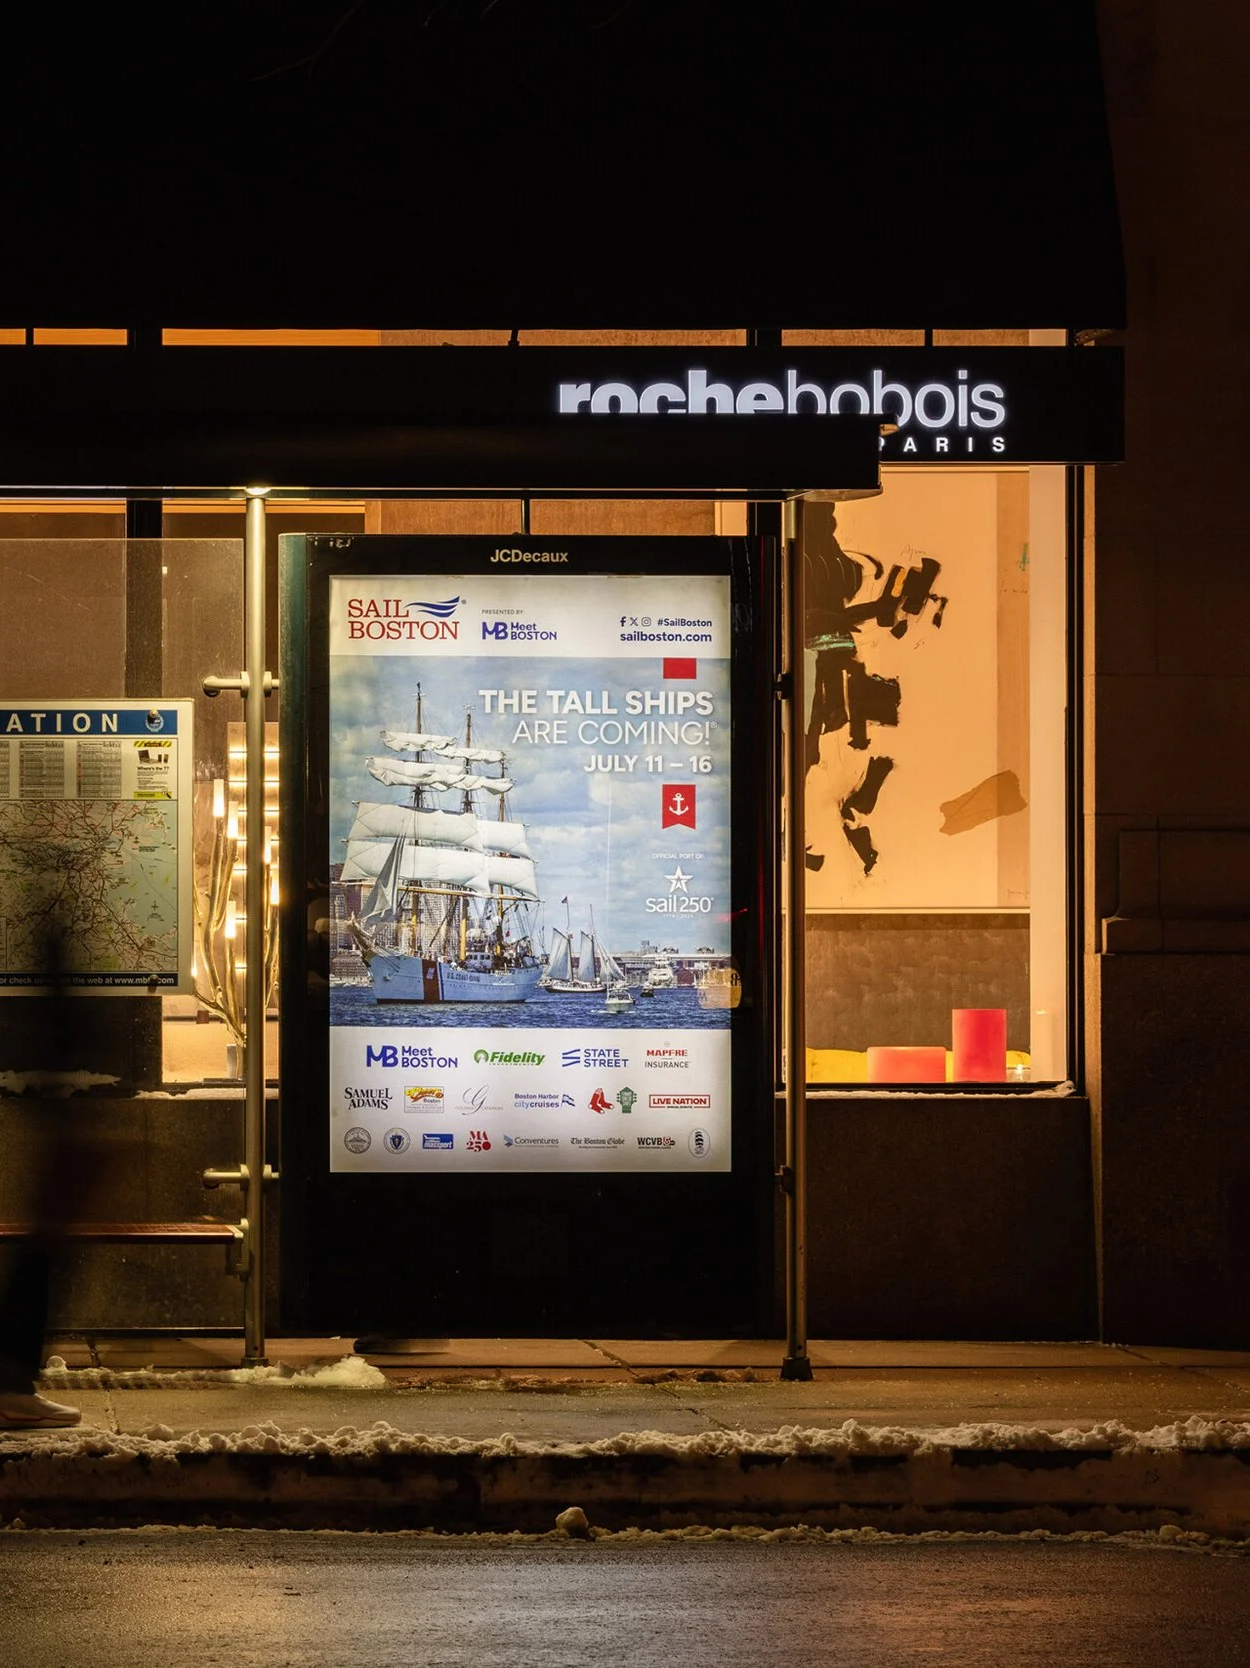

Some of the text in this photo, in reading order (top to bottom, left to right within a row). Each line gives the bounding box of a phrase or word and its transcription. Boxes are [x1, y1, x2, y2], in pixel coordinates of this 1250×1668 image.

[559, 370, 1005, 428] rochebobois
[878, 436, 1006, 452] ARIS
[491, 549, 568, 562] JCDecaux
[348, 599, 409, 618] SAIL
[511, 622, 536, 630] Meet
[658, 619, 712, 627] #SailBoston
[348, 621, 459, 640] BOSTON
[510, 631, 558, 641] BOSTON
[620, 631, 712, 642] sailboston.com
[479, 689, 714, 715] THE TALL SHIPS
[512, 720, 568, 745] ARE
[584, 755, 712, 773] JULY 11 16
[402, 1046, 432, 1056] Meet
[584, 1049, 620, 1058] STATE
[646, 1049, 688, 1057] MAPFRE
[401, 1057, 458, 1068] BOSTON
[490, 1051, 545, 1066] Fidelity
[584, 1059, 628, 1068] STREET
[644, 1061, 690, 1069] INSURANCE
[344, 1087, 393, 1099] SAMUEL
[348, 1099, 389, 1110] ADAMS
[514, 1100, 560, 1109] citycruises
[470, 1131, 488, 1140] MA
[515, 1137, 559, 1145] Conventures
[637, 1137, 662, 1146] WCVB
